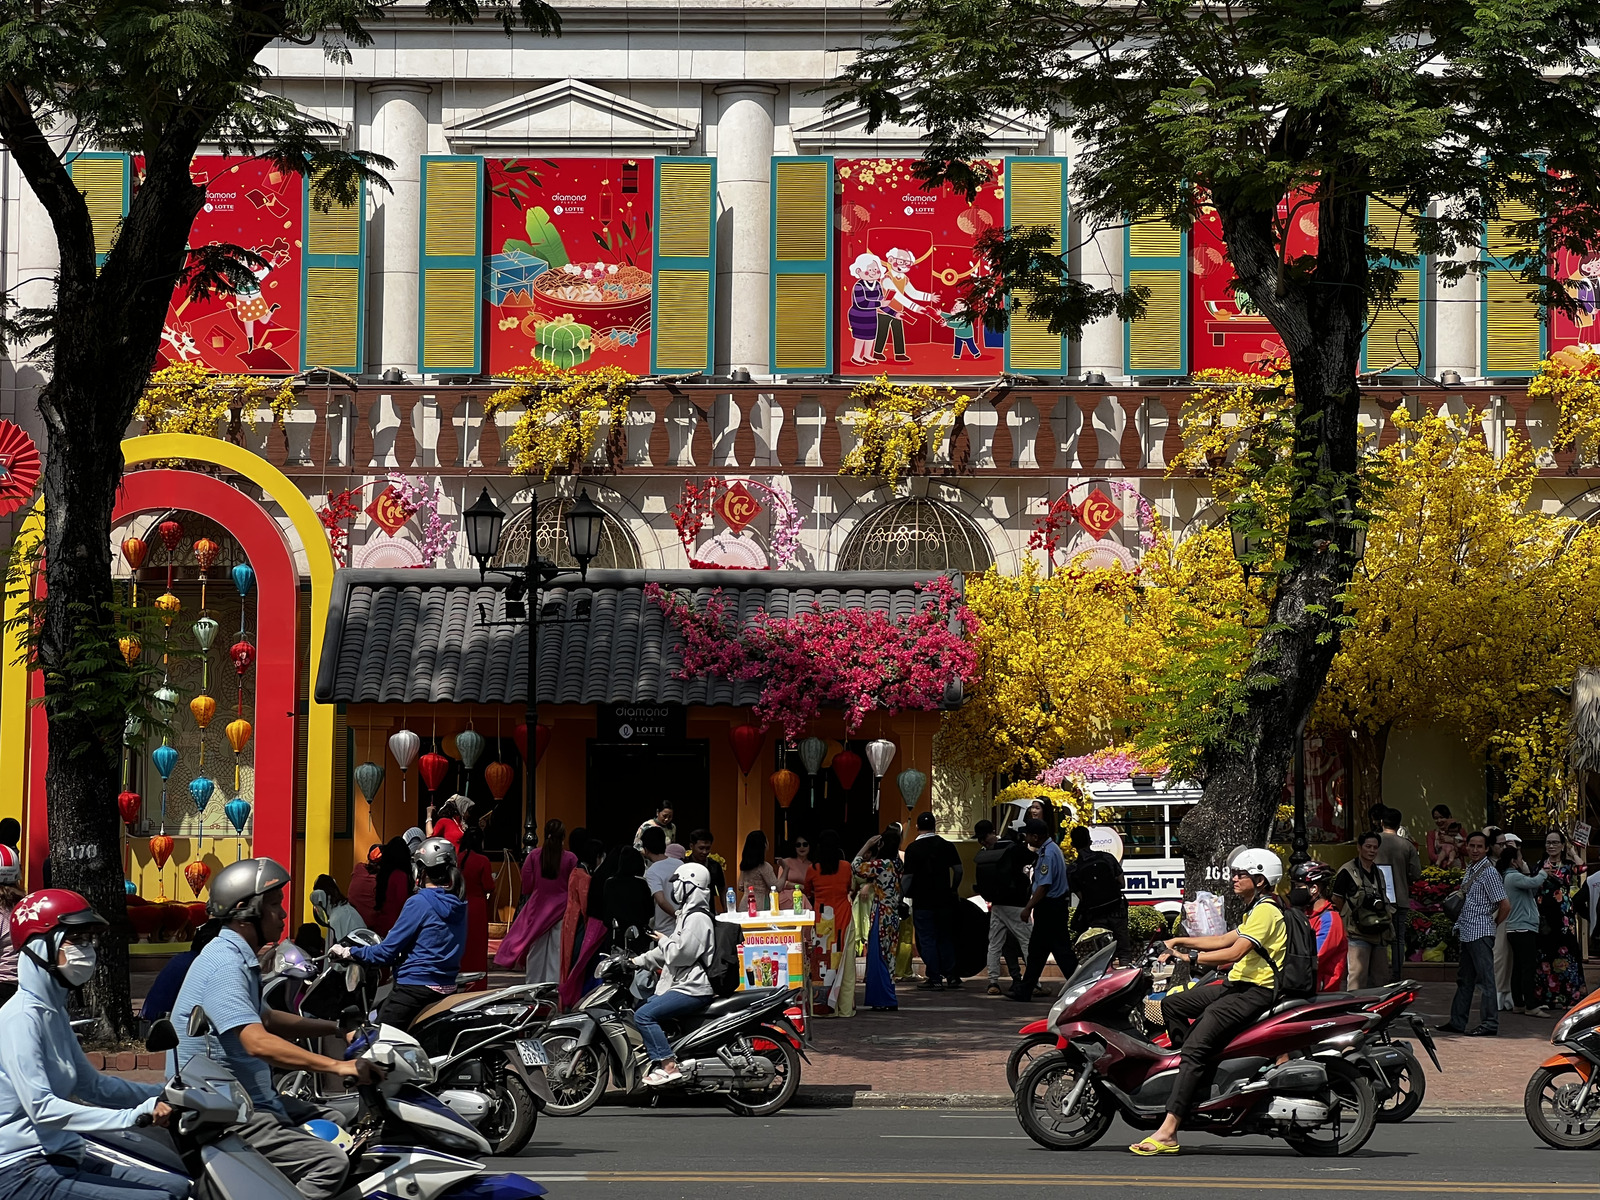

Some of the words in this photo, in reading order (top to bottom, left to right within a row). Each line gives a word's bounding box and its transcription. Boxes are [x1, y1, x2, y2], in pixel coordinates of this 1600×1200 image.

[551, 192, 587, 201] diamond
[902, 193, 937, 202] diamond
[615, 707, 669, 717] diamond
[68, 844, 98, 860] 170
[1205, 865, 1231, 881] 168
